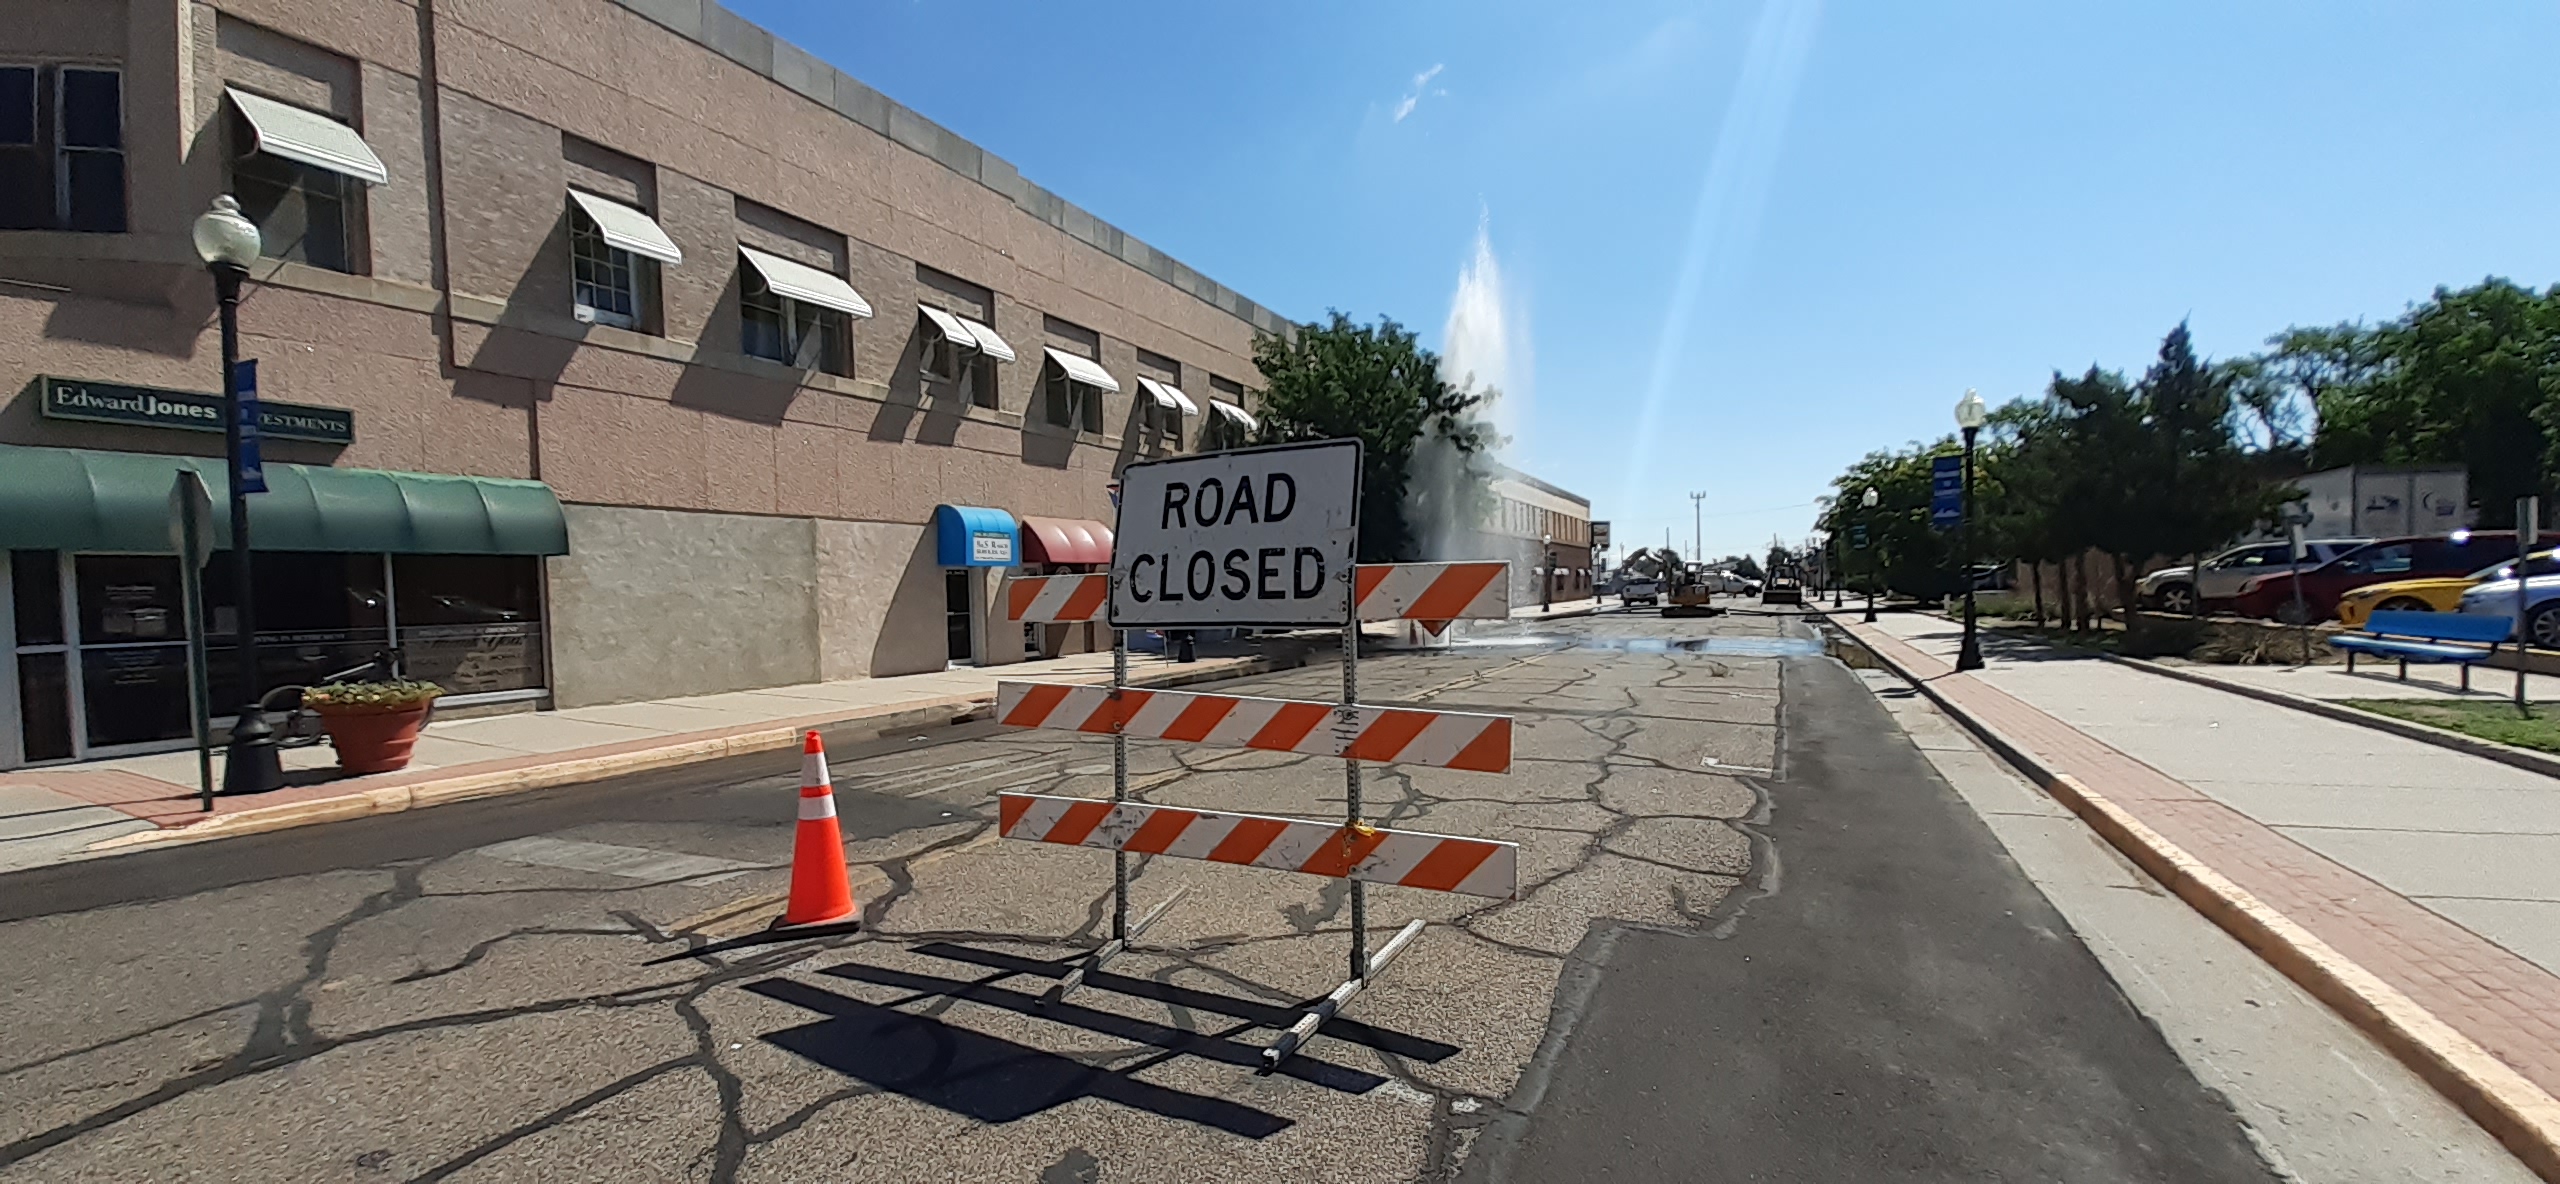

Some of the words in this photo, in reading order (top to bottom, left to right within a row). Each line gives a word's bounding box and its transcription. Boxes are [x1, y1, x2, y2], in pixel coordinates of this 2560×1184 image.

[258, 412, 347, 432] ESTMENTS
[1161, 472, 1297, 529] ROAD
[1129, 546, 1326, 604] CLOSED
